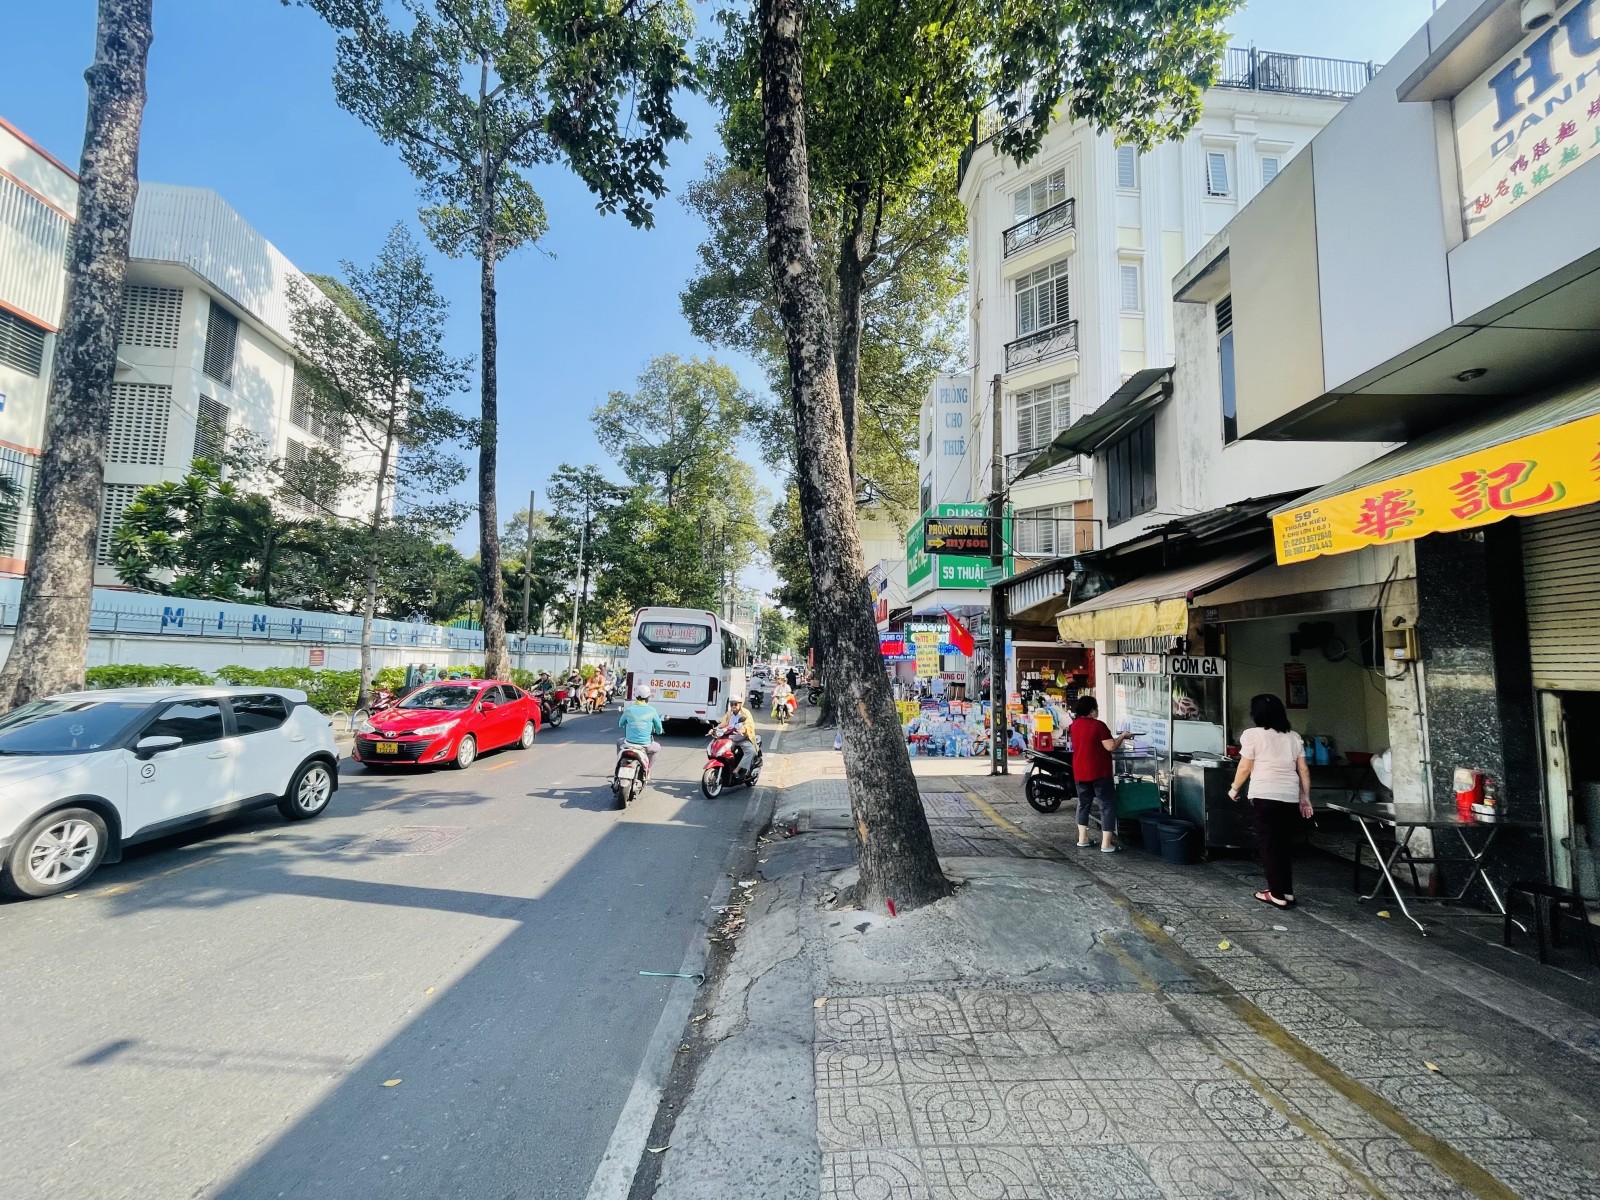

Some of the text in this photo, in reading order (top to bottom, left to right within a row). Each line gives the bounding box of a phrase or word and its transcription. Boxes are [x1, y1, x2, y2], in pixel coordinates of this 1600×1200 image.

[940, 384, 968, 403] PHÒNG
[945, 412, 963, 428] CHO
[1352, 442, 1600, 540] 華記
[928, 523, 952, 535] PHÒNG
[954, 525, 968, 535] CHO
[942, 566, 954, 579] 59
[162, 606, 304, 635] MINH
[1172, 655, 1199, 674] CƠM
